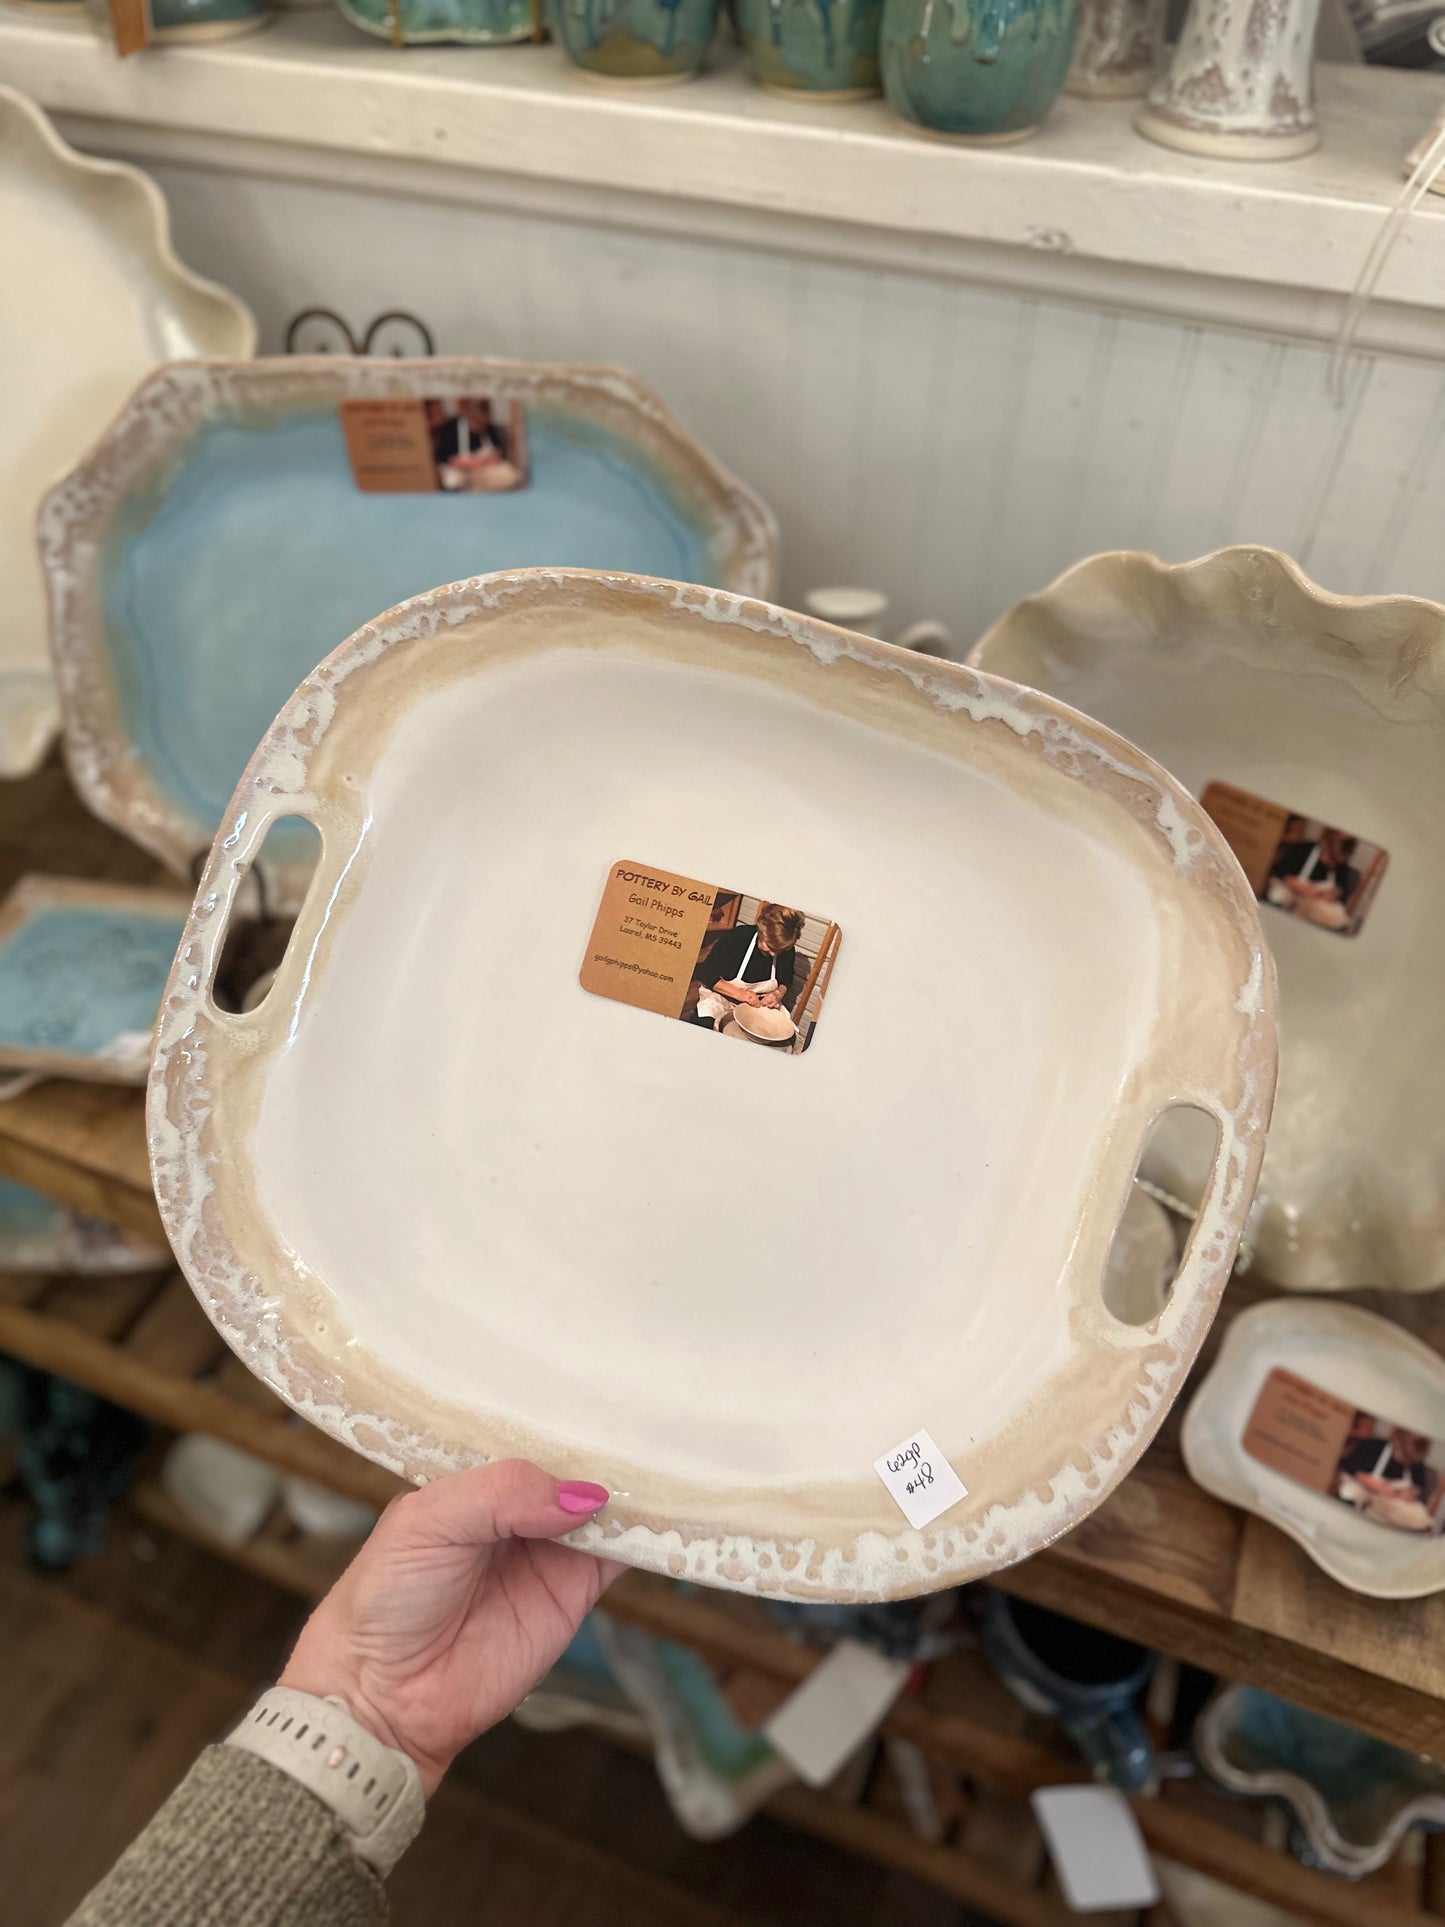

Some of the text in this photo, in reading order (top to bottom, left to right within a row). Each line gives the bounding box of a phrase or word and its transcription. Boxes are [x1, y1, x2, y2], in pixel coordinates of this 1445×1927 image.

[615, 869, 713, 906] POTTERY BY GAIL
[628, 893, 685, 918] Gail Phipps
[623, 915, 679, 938] 37 Taylor Drive
[645, 932, 658, 942] MS
[658, 936, 683, 949] 39443
